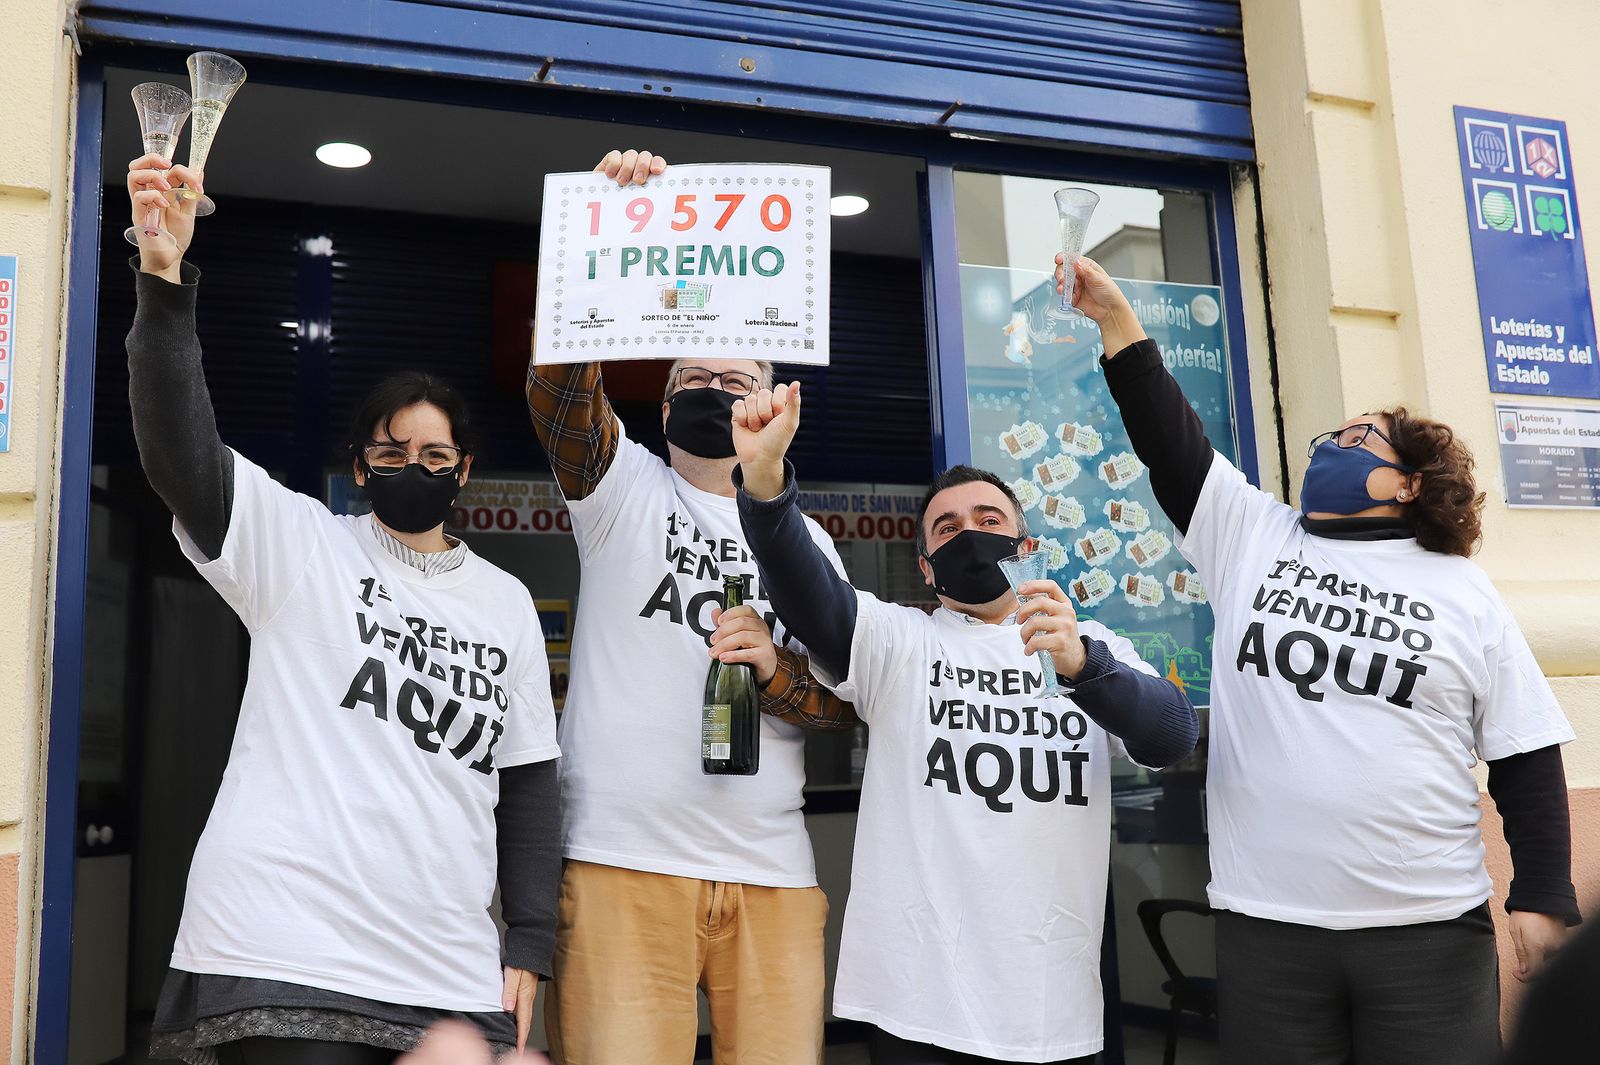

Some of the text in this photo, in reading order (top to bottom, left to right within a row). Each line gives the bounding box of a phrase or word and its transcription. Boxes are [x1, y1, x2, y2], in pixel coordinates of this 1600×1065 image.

[586, 194, 792, 236] 19570
[620, 244, 785, 278] PREMIO
[770, 319, 798, 328] Nacional
[1490, 316, 1565, 344] Loterías y
[1495, 340, 1593, 365] Apuestas del
[1496, 363, 1550, 385] Estado
[1521, 426, 1600, 437] Apuestas del Estad
[1557, 417, 1562, 425] y
[1538, 447, 1576, 456] HORARIO
[852, 494, 867, 513] DE
[870, 494, 891, 513] SAN
[1294, 565, 1435, 622] PREMIO
[1252, 584, 1433, 652] VENDIDO
[1236, 621, 1428, 709] AQUÍ
[956, 667, 1043, 696] PREM
[339, 657, 504, 776] AQUÍ
[928, 694, 1088, 741] VENDIDO
[924, 737, 1090, 813] AQUÍ
